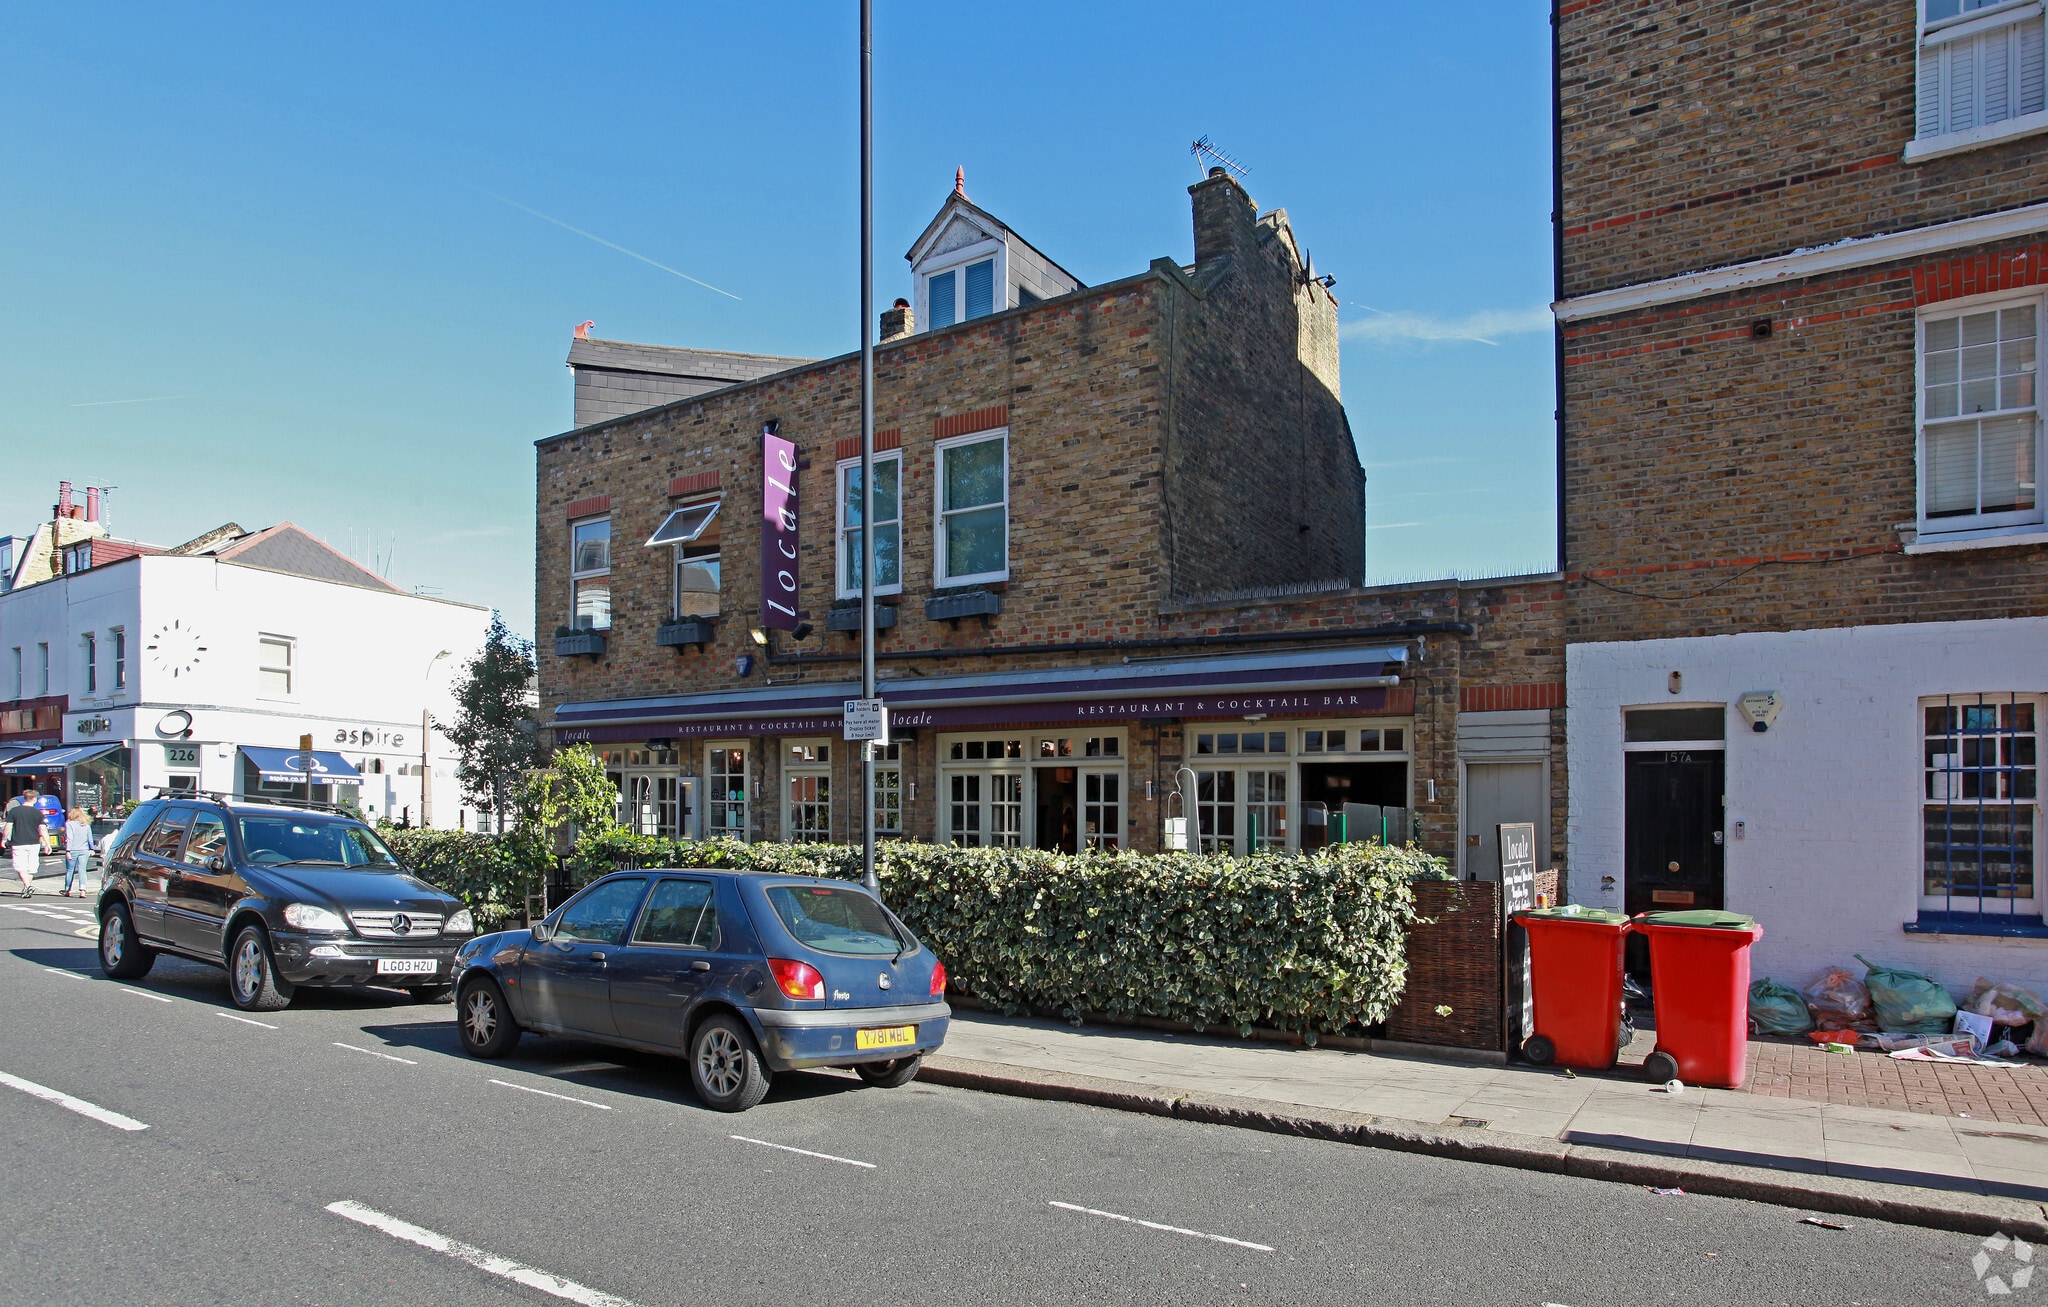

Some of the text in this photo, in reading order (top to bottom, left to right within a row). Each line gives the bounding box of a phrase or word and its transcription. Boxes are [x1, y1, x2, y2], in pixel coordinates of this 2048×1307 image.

[767, 449, 797, 618] locale
[1078, 695, 1359, 715] RESTAURANT & COCKTAIL BAR
[77, 714, 112, 737] aspire
[892, 711, 932, 726] locale
[334, 727, 404, 749] aspire
[564, 728, 591, 740] locale
[678, 723, 743, 734] RESTAURANT
[760, 721, 815, 730] COCKTAIL
[822, 720, 844, 728] BAR
[169, 749, 195, 761] 226
[1664, 751, 1692, 763] 157A
[382, 961, 433, 972] LG03 HZU
[863, 1026, 909, 1045] Y781 MBL
